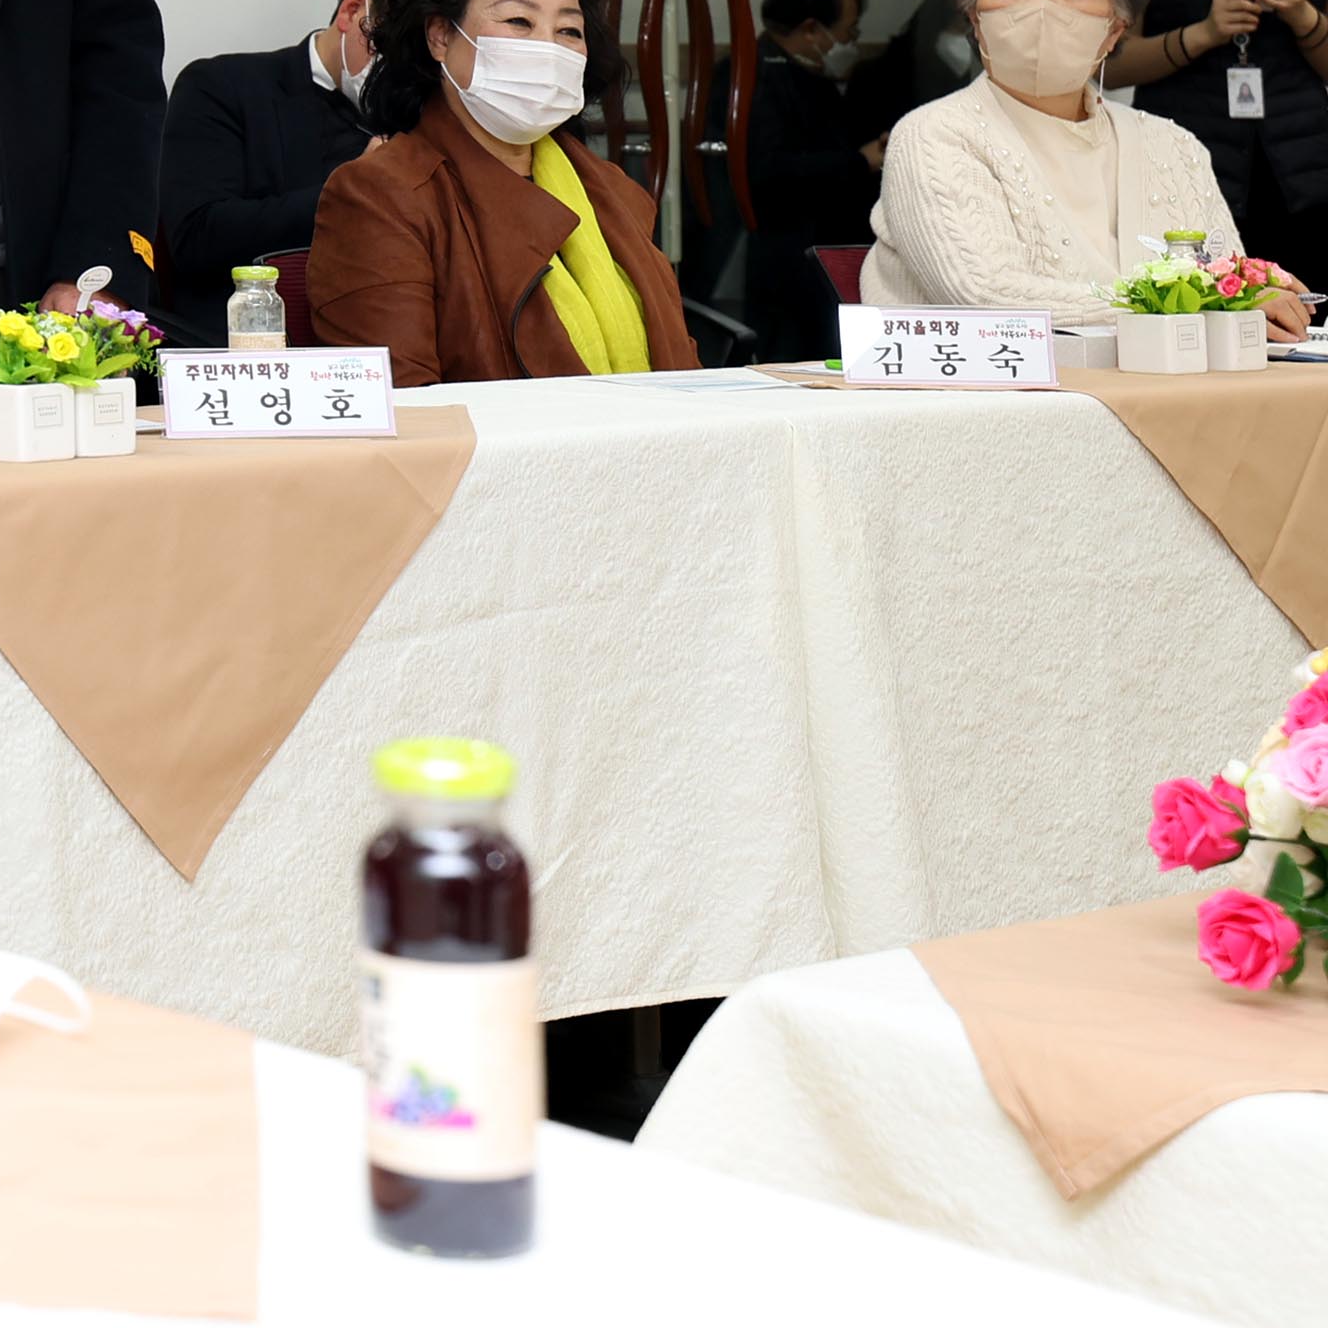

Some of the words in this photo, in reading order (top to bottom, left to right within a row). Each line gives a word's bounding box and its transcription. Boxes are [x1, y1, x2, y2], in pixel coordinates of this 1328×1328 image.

[185, 362, 290, 381] 주민자치회장
[873, 341, 1025, 378] 김동숙
[196, 387, 362, 426] 설영호
